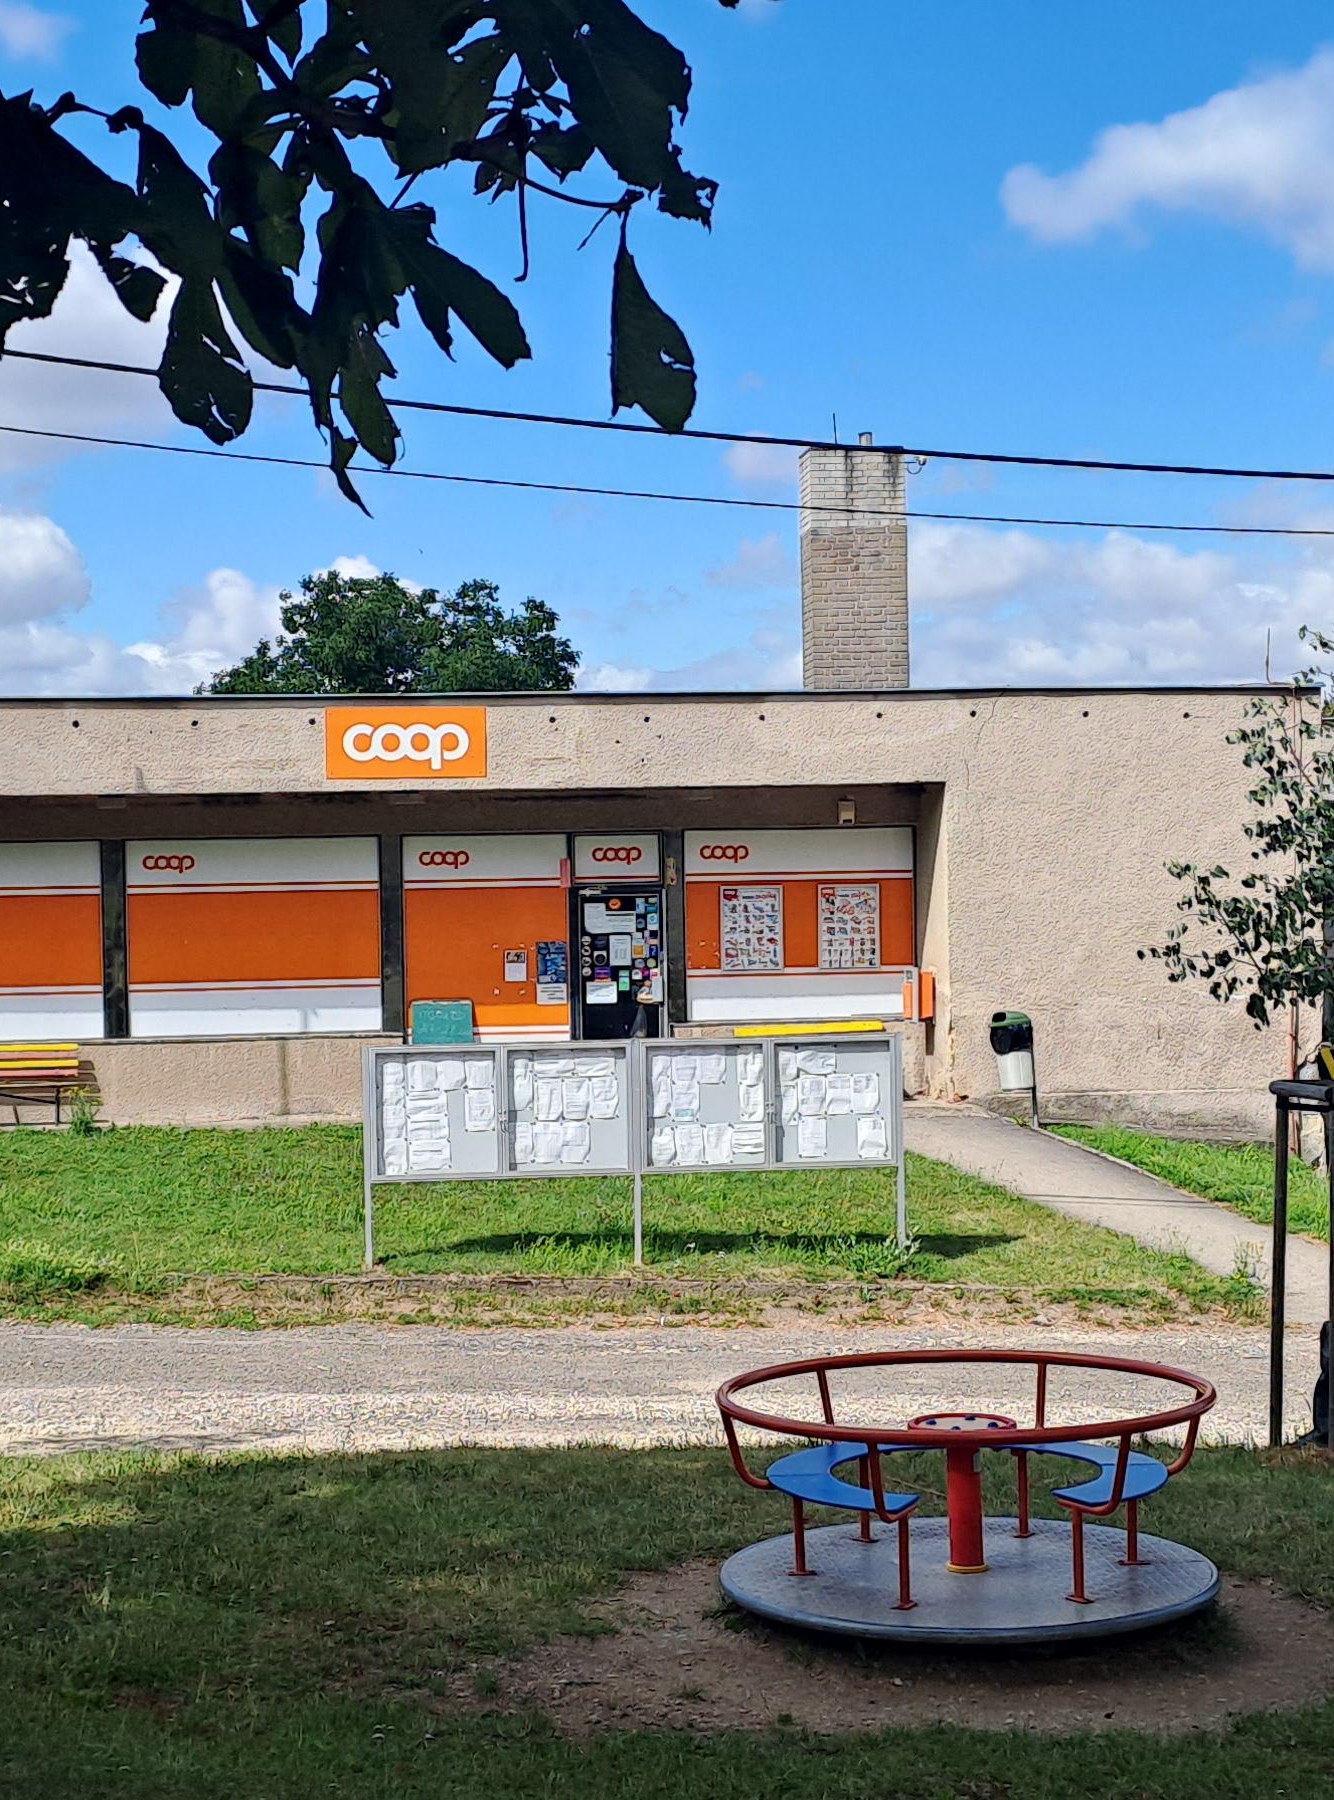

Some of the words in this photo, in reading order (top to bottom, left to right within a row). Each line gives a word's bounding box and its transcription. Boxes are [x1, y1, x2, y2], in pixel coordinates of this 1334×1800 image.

[343, 723, 469, 770] coop
[418, 850, 470, 869] coop
[591, 846, 642, 865] coop
[699, 844, 749, 863] coop
[142, 855, 195, 873] coop
